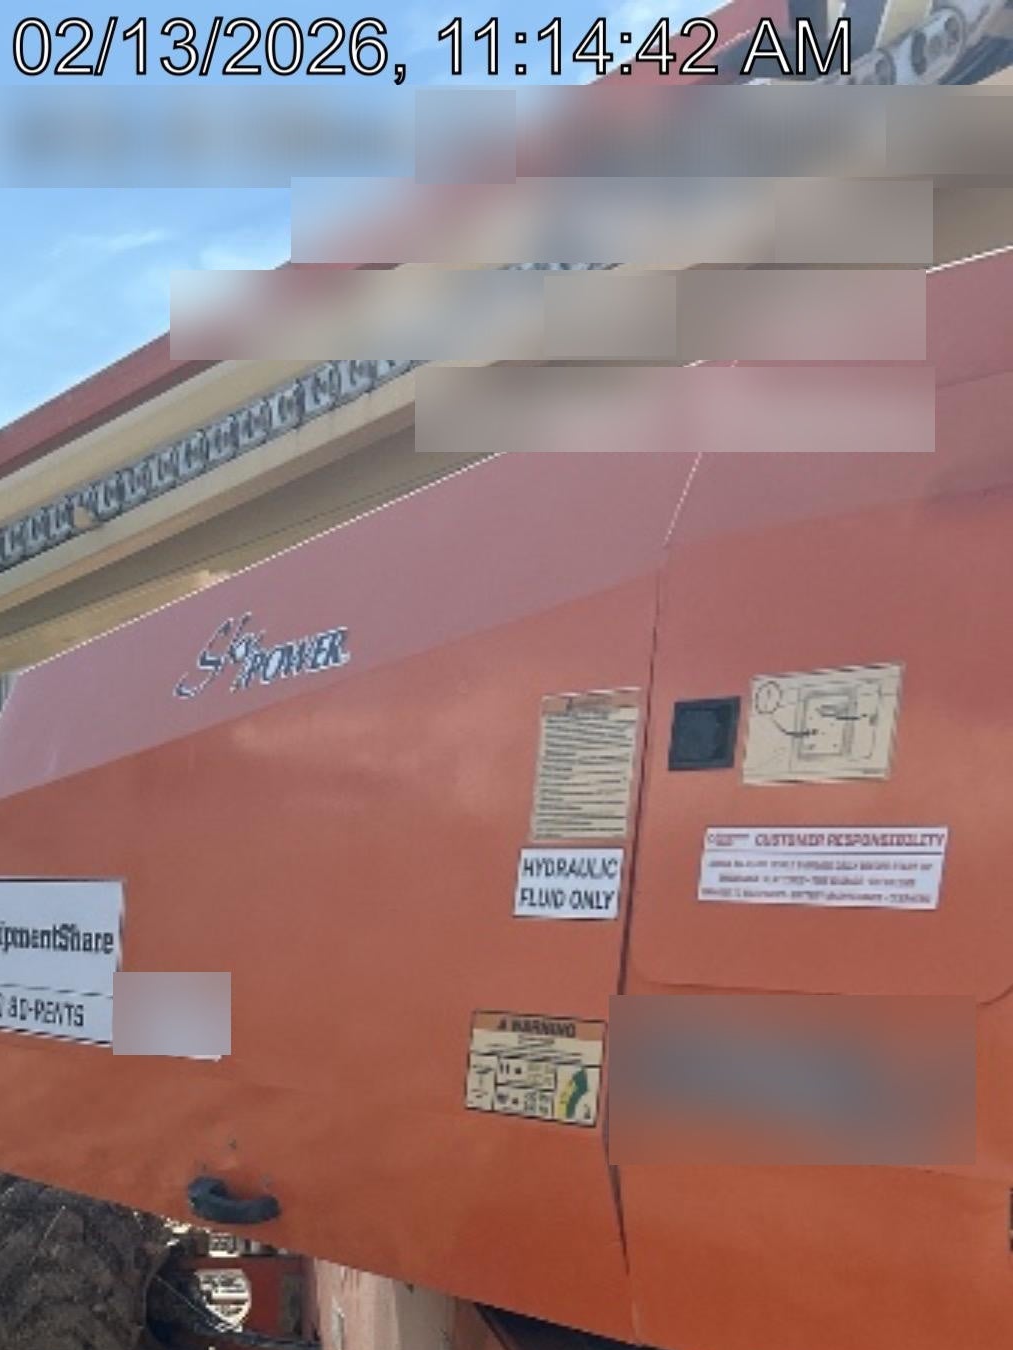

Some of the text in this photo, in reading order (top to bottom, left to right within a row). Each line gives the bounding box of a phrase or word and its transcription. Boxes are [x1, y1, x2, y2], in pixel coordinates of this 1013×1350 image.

[522, 856, 618, 879] HYDRAULIC
[519, 887, 616, 911] FLUID ONLY
[511, 1018, 576, 1039] WARNING
